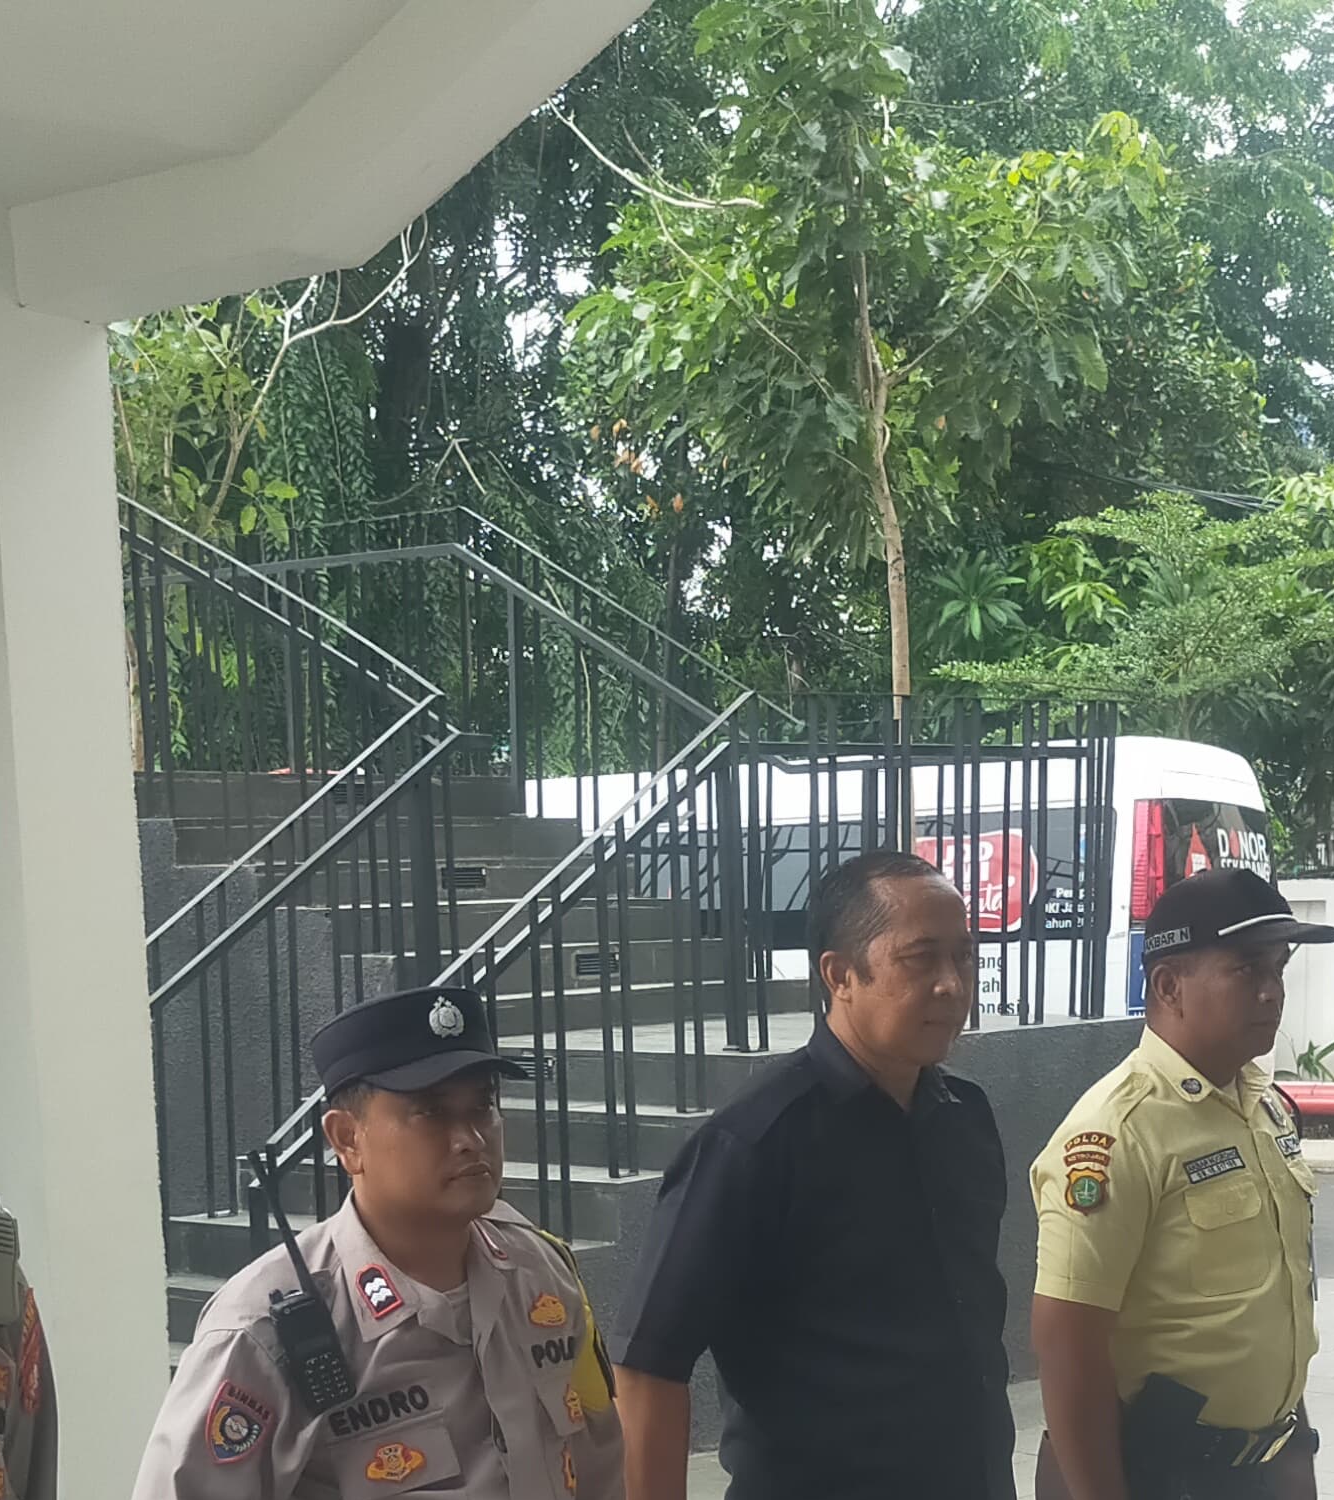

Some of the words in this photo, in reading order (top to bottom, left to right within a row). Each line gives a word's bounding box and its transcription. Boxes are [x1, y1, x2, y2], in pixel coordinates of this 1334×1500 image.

[1045, 917, 1072, 928] ahun
[1179, 927, 1189, 941] N
[1067, 1133, 1108, 1150] POLDA
[328, 1384, 429, 1437] ENDRO
